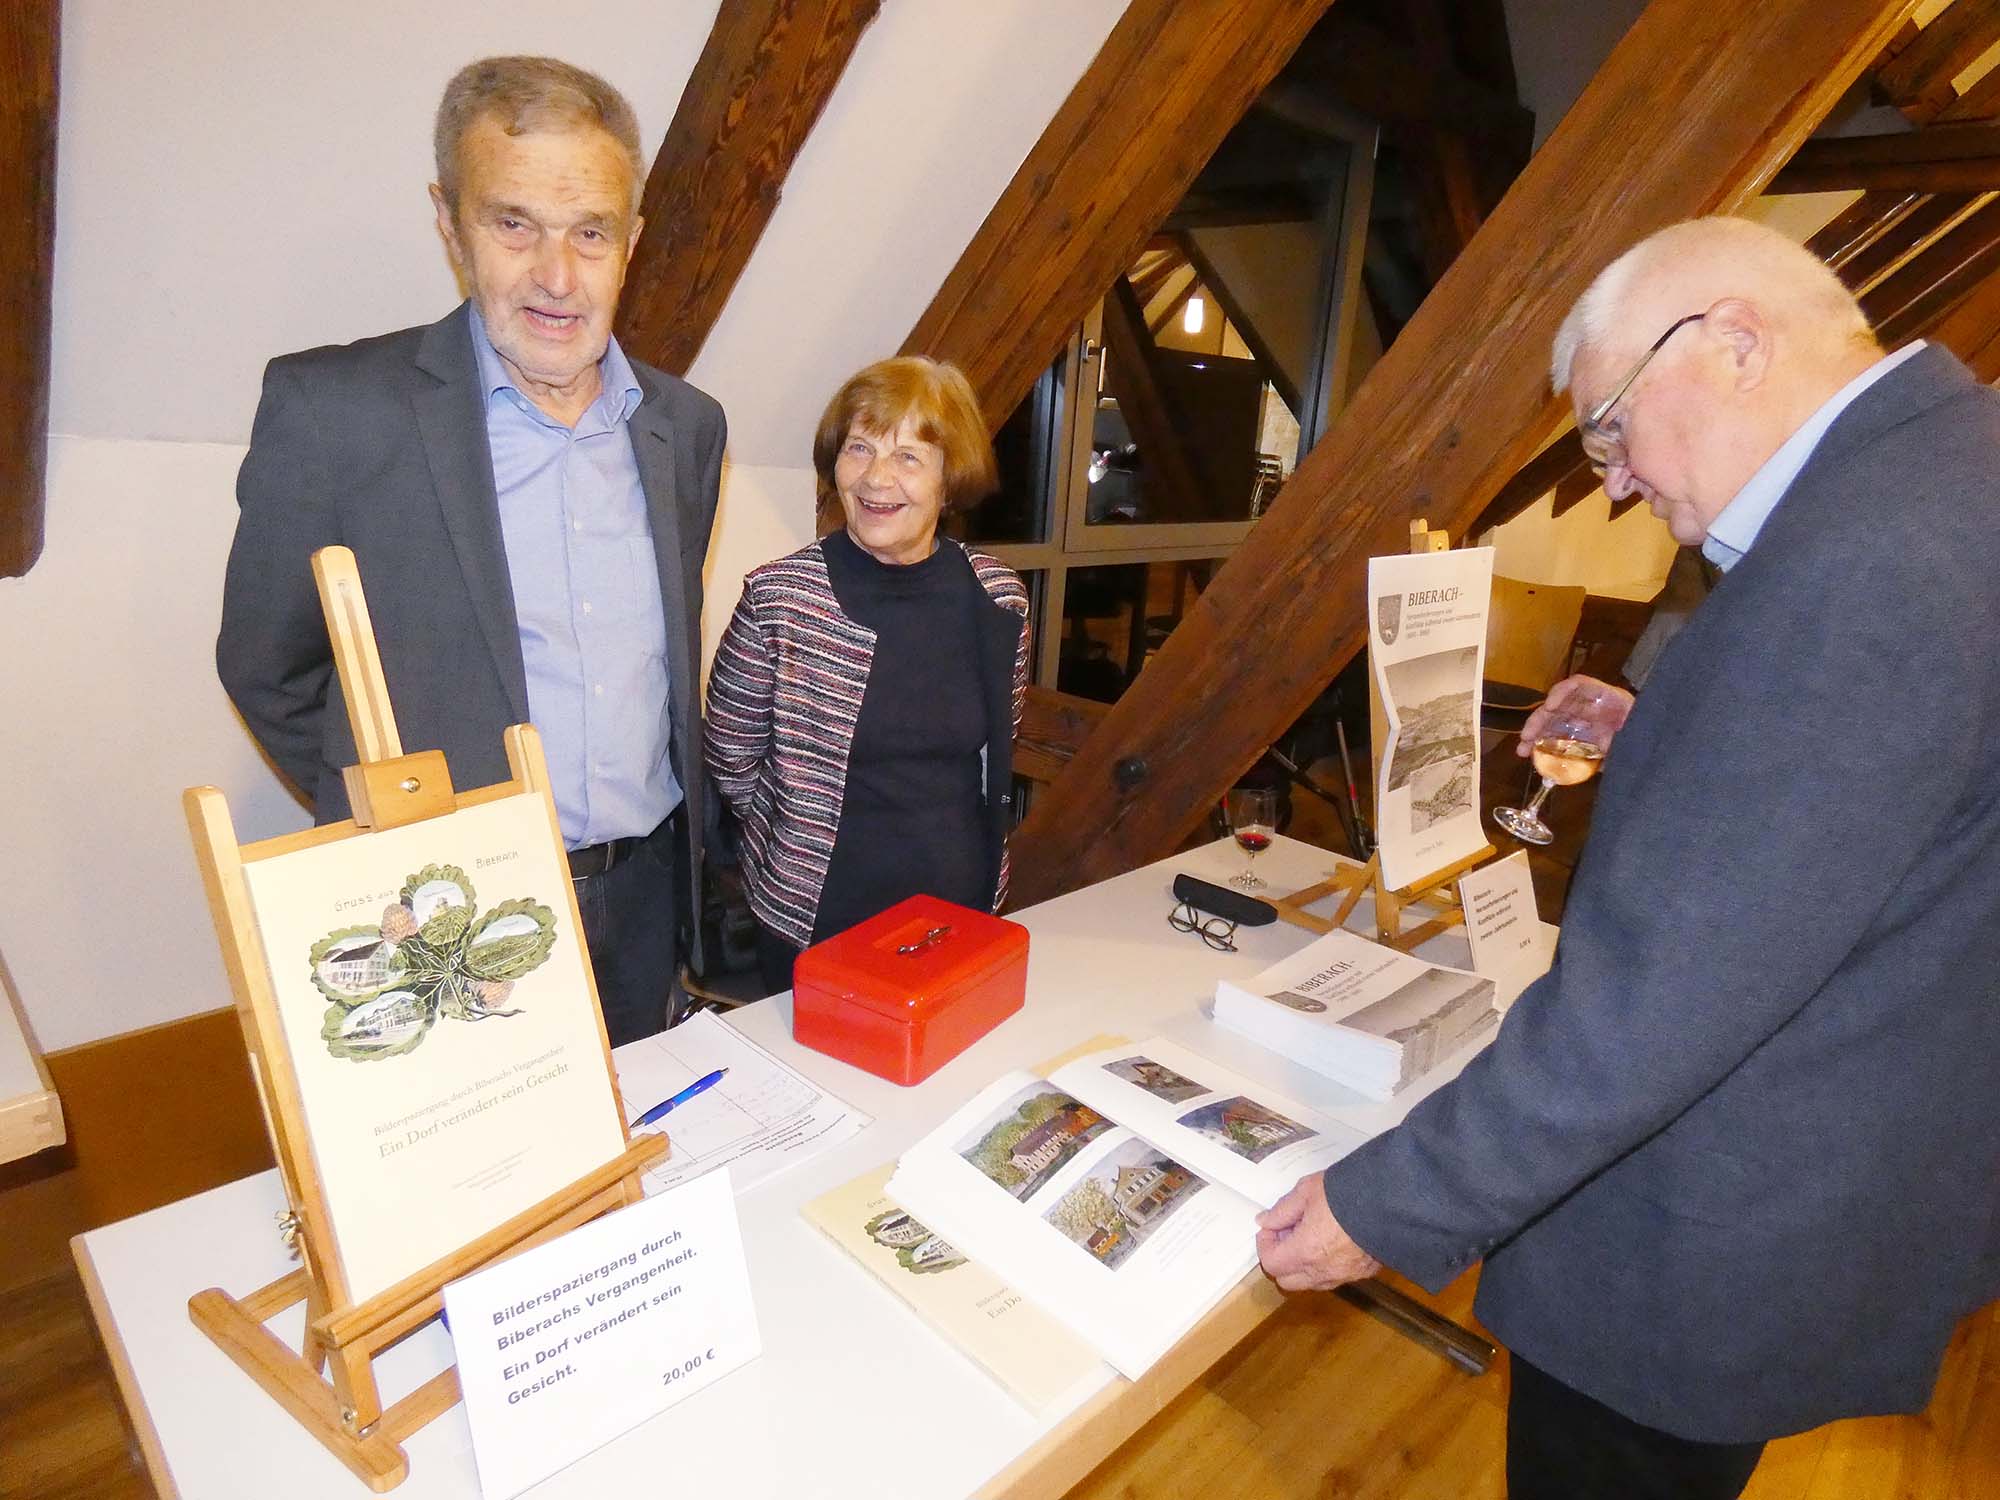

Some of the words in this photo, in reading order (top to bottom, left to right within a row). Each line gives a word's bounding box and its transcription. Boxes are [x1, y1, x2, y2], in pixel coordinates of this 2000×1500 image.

[379, 1141, 403, 1158] Ein
[407, 1119, 439, 1145] Dorf
[502, 1084, 524, 1099] sein
[526, 1063, 569, 1088] Gesicht
[492, 1251, 638, 1326] Bilderspaziergang
[641, 1230, 682, 1256] durch
[497, 1304, 581, 1351] Biberachs
[585, 1248, 697, 1307] Vergangenheit.
[1003, 1296, 1022, 1308] Do
[503, 1360, 530, 1381] Ein
[535, 1338, 570, 1365] Dorf
[574, 1300, 648, 1344] verändert
[652, 1283, 682, 1306] sein
[662, 1355, 702, 1386] 20,00
[705, 1347, 716, 1361] €
[508, 1363, 577, 1405] Gesicht.
